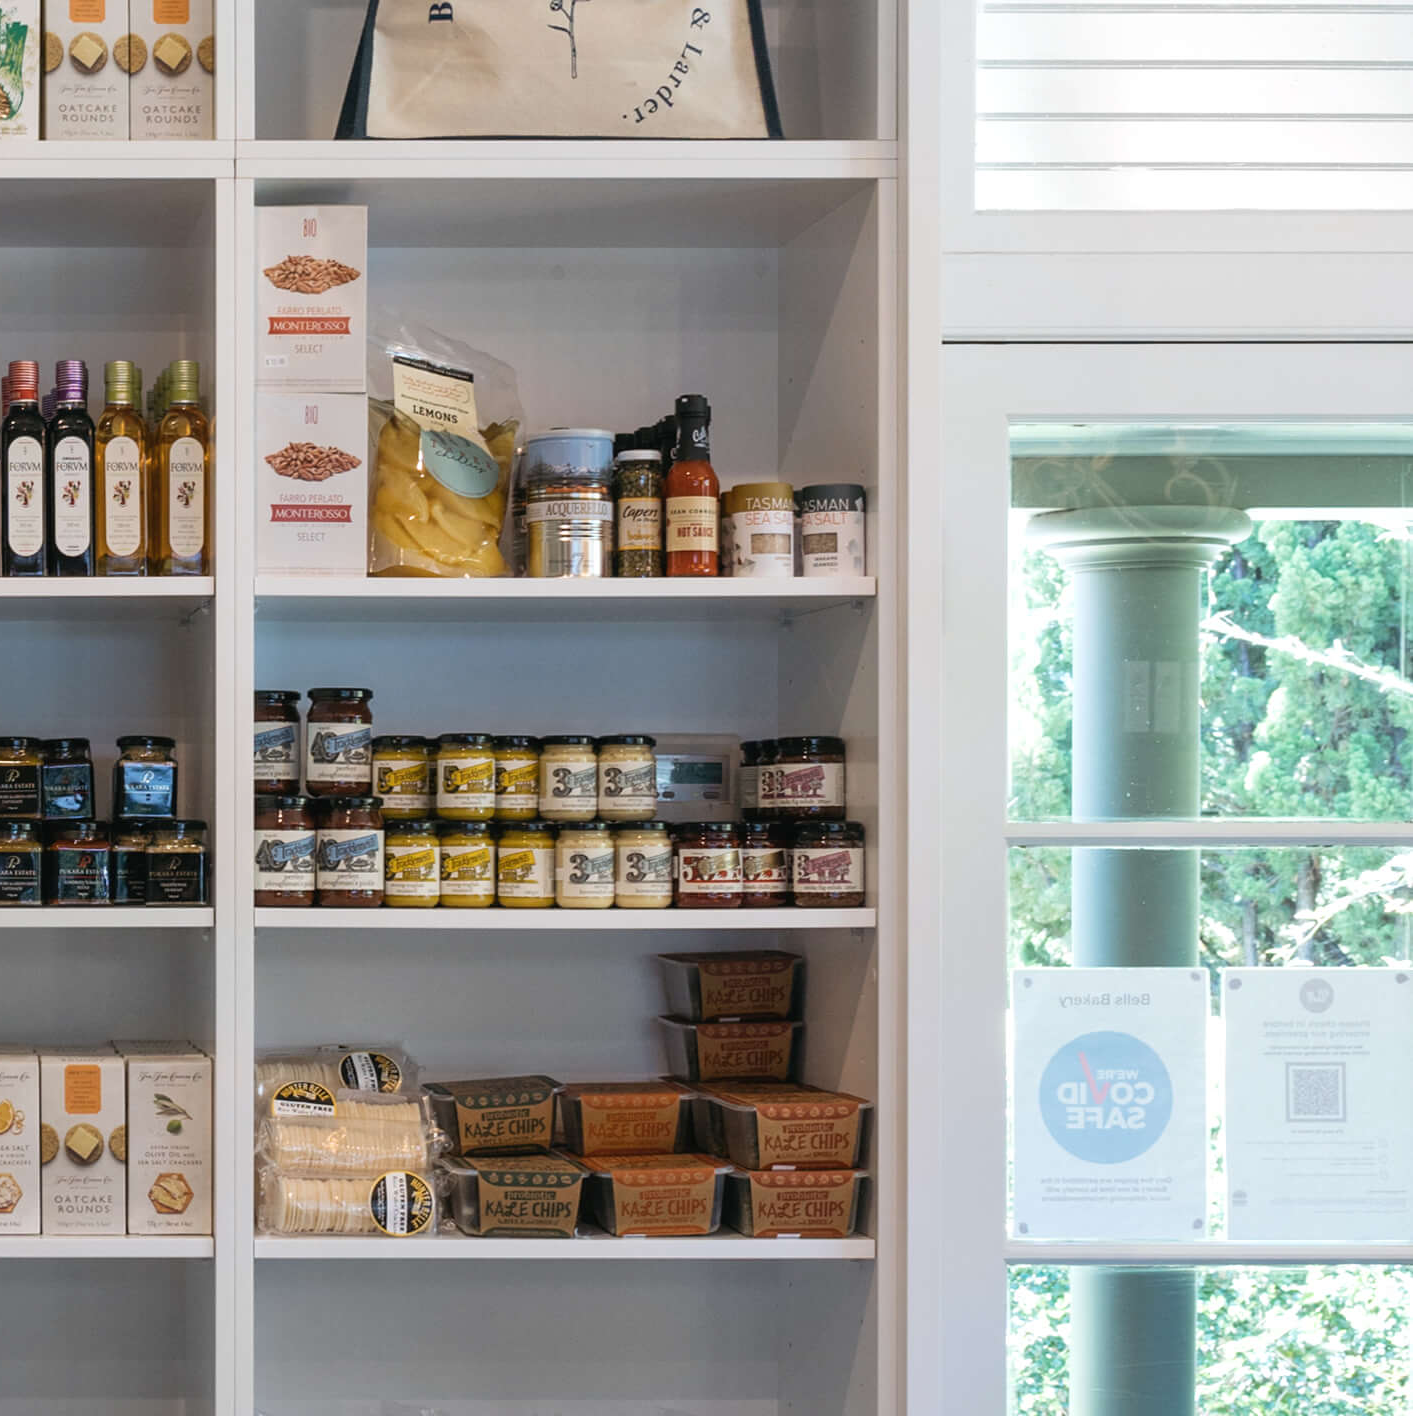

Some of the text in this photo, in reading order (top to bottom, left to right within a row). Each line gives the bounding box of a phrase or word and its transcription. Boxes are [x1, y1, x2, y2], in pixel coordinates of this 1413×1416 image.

[690, 7, 711, 30] &
[622, 42, 704, 124] Larder.
[58, 104, 118, 113] OATCAKE
[142, 105, 202, 114] OATCAKE
[62, 114, 114, 122] ROUNDS
[146, 115, 199, 124] ROUNDS
[304, 218, 316, 237] BIO
[273, 320, 346, 332] MONTEROSSO
[294, 344, 323, 353] SELECT
[305, 406, 318, 424] BIO
[413, 404, 458, 424] LEMONS
[280, 494, 344, 504] FARRO PERLATO
[275, 510, 347, 519] MONTEROSSO
[546, 502, 608, 516] ACQUERELLO
[622, 505, 659, 522] Capers
[746, 512, 770, 526] SEA
[814, 512, 849, 525] SALT
[297, 532, 326, 542] SELECT
[678, 527, 714, 538] HOT SAUCE
[706, 986, 785, 1005] KALE CHIPS
[704, 1049, 784, 1068] KALE CHIPS
[464, 1117, 546, 1138] KALE CHIPS
[588, 1121, 672, 1138] KALE CHIPS
[764, 1134, 850, 1152] KALE CHIPS
[54, 1195, 113, 1204] OATCAKE
[58, 1206, 111, 1214] ROUNDS
[485, 1200, 572, 1218] KALE CHIPS
[620, 1198, 707, 1216] KALE CHIPS
[758, 1200, 844, 1218] KALE CHIPS
